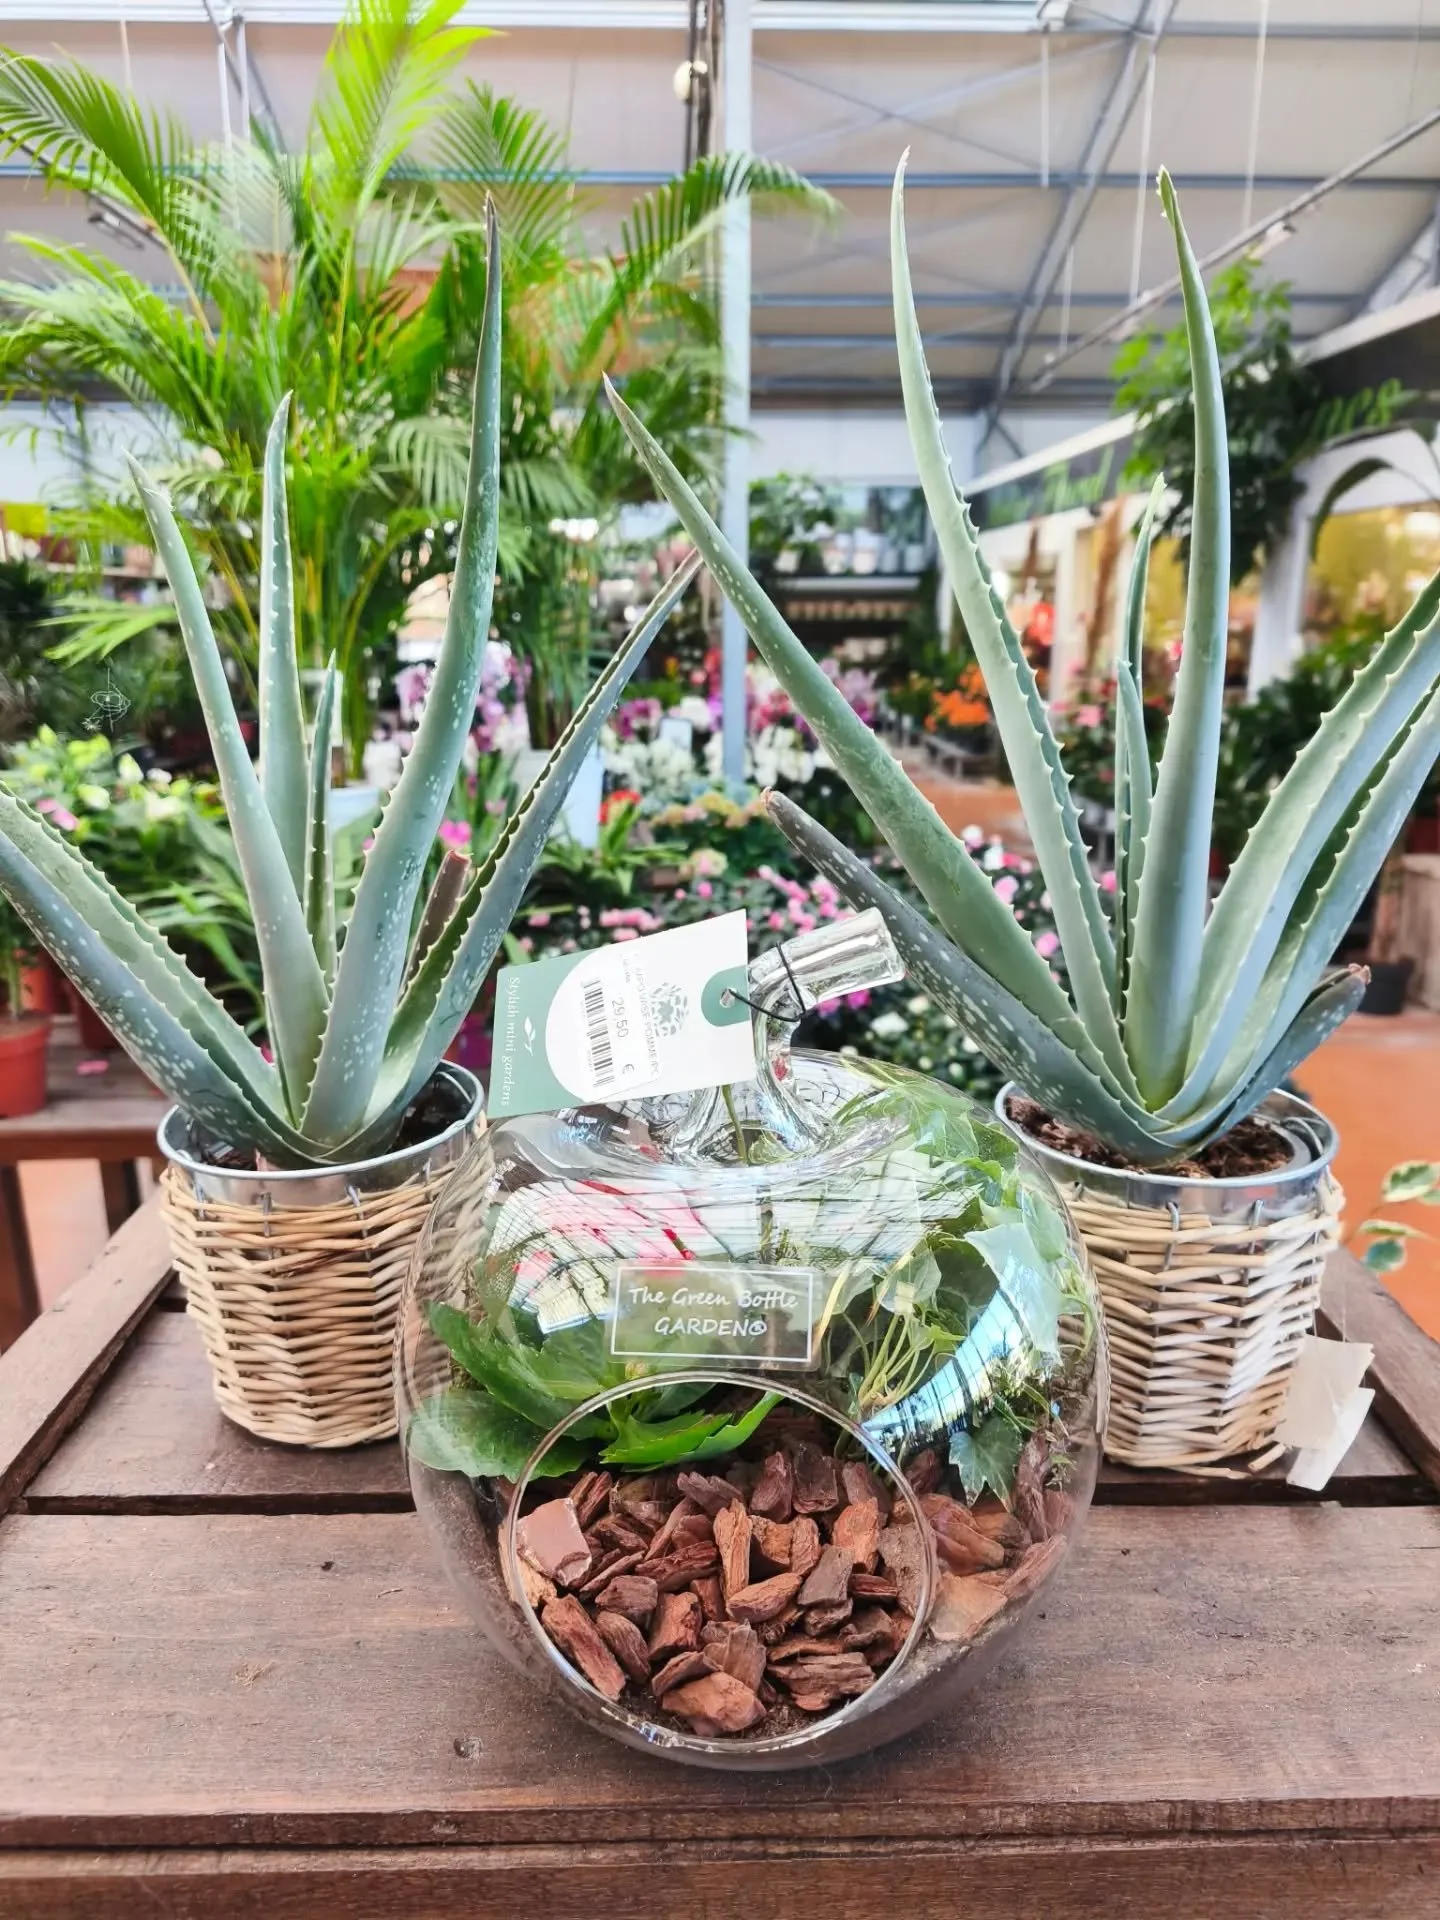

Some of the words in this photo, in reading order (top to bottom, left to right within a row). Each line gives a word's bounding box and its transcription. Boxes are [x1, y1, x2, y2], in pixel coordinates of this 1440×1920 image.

[507, 976, 520, 1018] Stylish
[505, 1022, 517, 1052] mini
[501, 1055, 515, 1106] gardens
[622, 1063, 635, 1075] €
[628, 1286, 666, 1305] The
[671, 1287, 731, 1306] Green
[736, 1290, 800, 1309] Bottle
